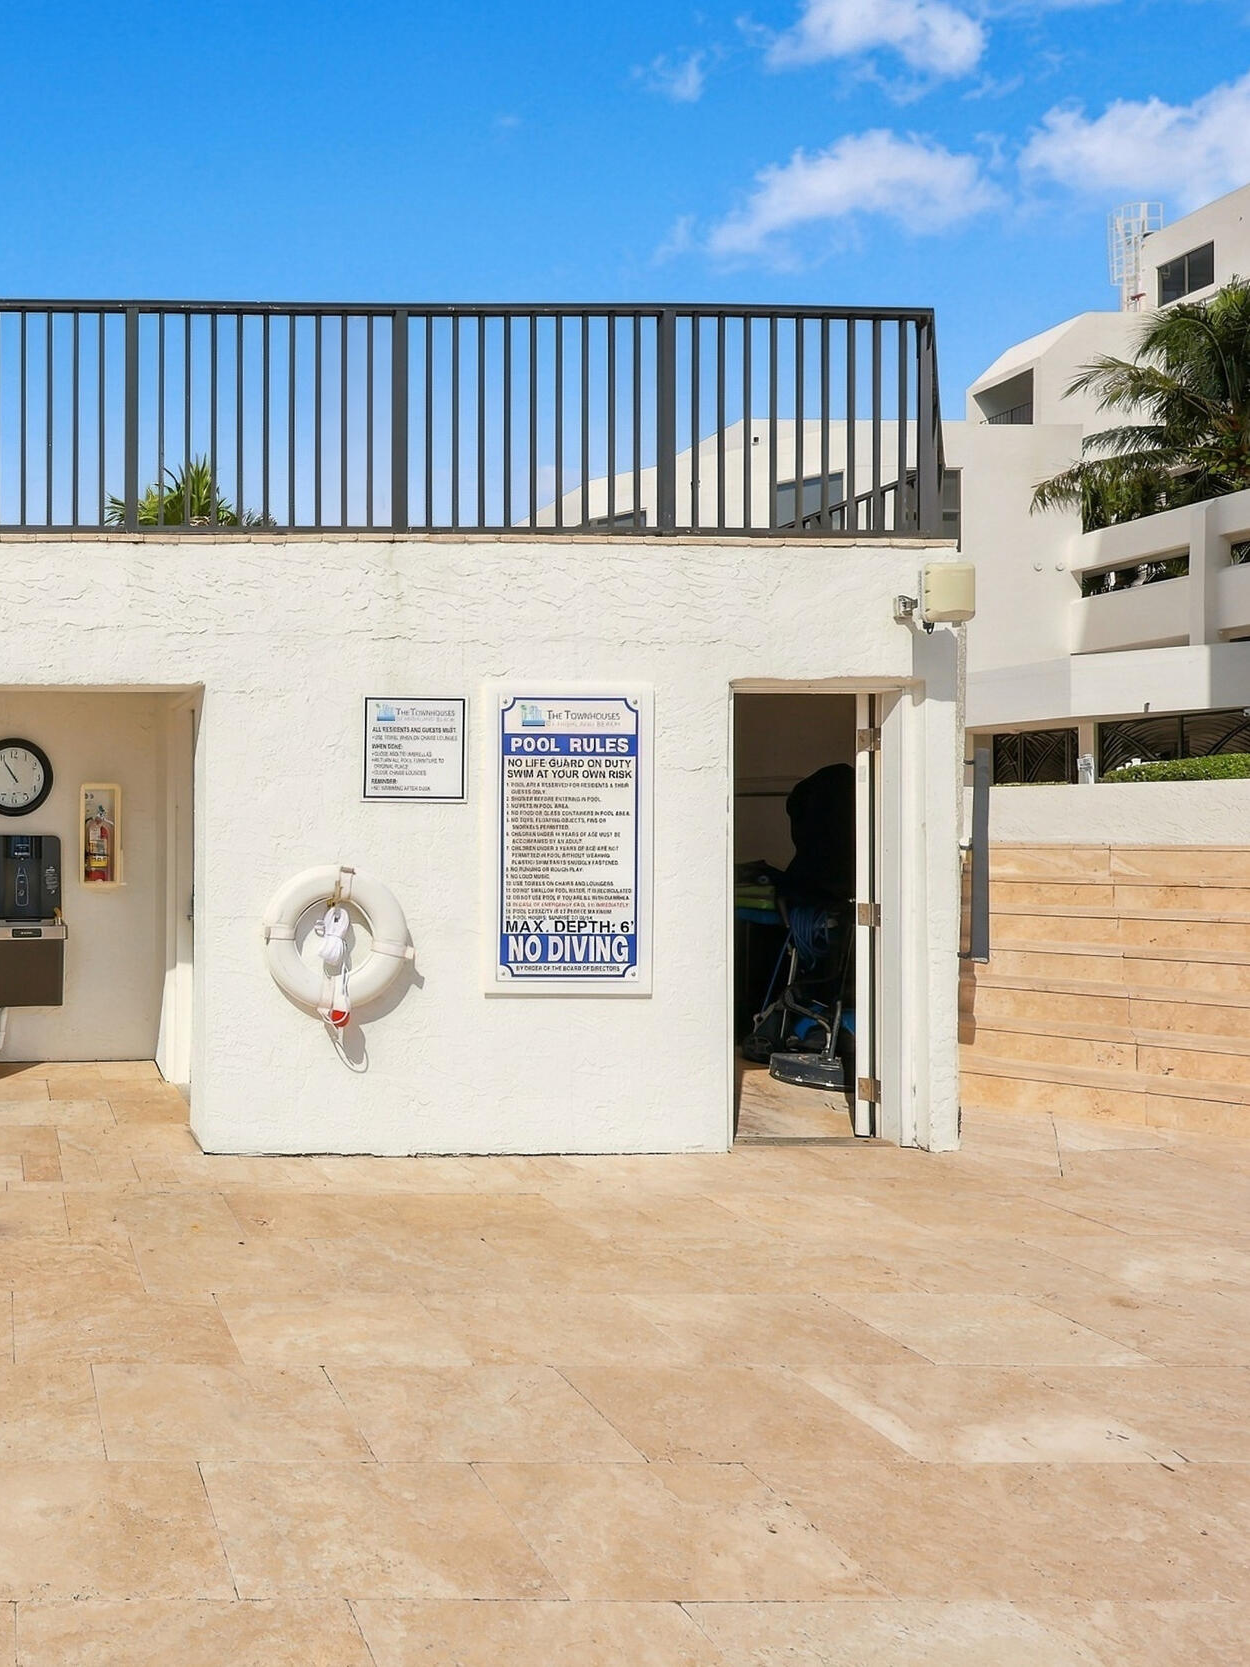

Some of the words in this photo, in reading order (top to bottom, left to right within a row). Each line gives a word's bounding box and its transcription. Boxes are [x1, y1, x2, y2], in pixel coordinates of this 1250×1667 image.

[510, 736, 560, 754] POOL
[570, 736, 629, 754] RULES
[10, 751, 18, 760] 12
[508, 759, 522, 768] NO
[526, 759, 546, 768] LIFE
[548, 759, 584, 768] GUARD
[588, 759, 602, 768] ON
[604, 759, 632, 768] DUTY
[507, 770, 534, 779] SWIM
[536, 770, 549, 779] AT
[552, 770, 579, 779] YOUR
[582, 770, 606, 779] OWN
[608, 770, 632, 779] RISK
[506, 920, 549, 933] MAX.
[554, 920, 616, 933] DEPTH:
[620, 920, 634, 933] 6'
[508, 934, 542, 963] NO
[548, 934, 630, 963] DIVING
